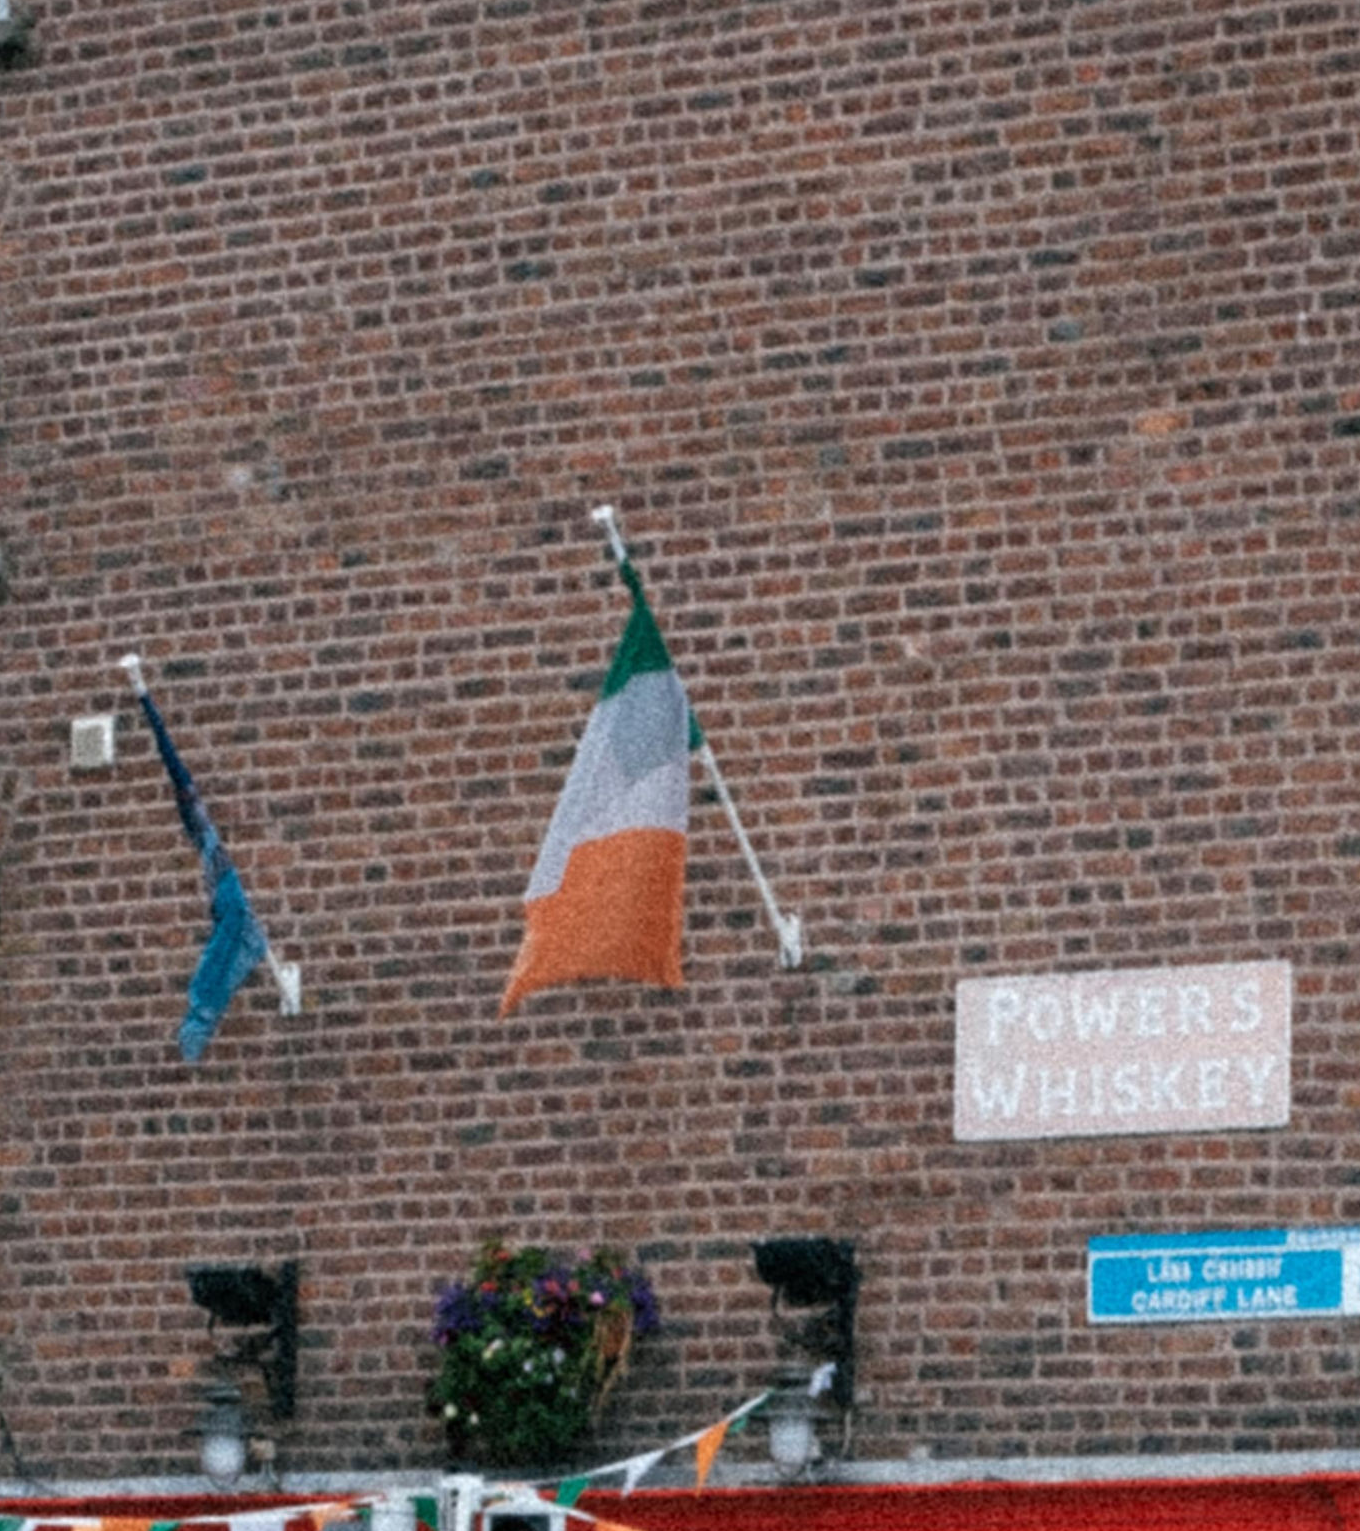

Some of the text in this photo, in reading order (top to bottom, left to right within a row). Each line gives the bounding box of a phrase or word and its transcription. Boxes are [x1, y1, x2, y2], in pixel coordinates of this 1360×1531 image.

[985, 980, 1265, 1046] POWERS
[970, 1054, 1277, 1120] WHISKEY
[1131, 1283, 1298, 1314] CARDIFF LANE
